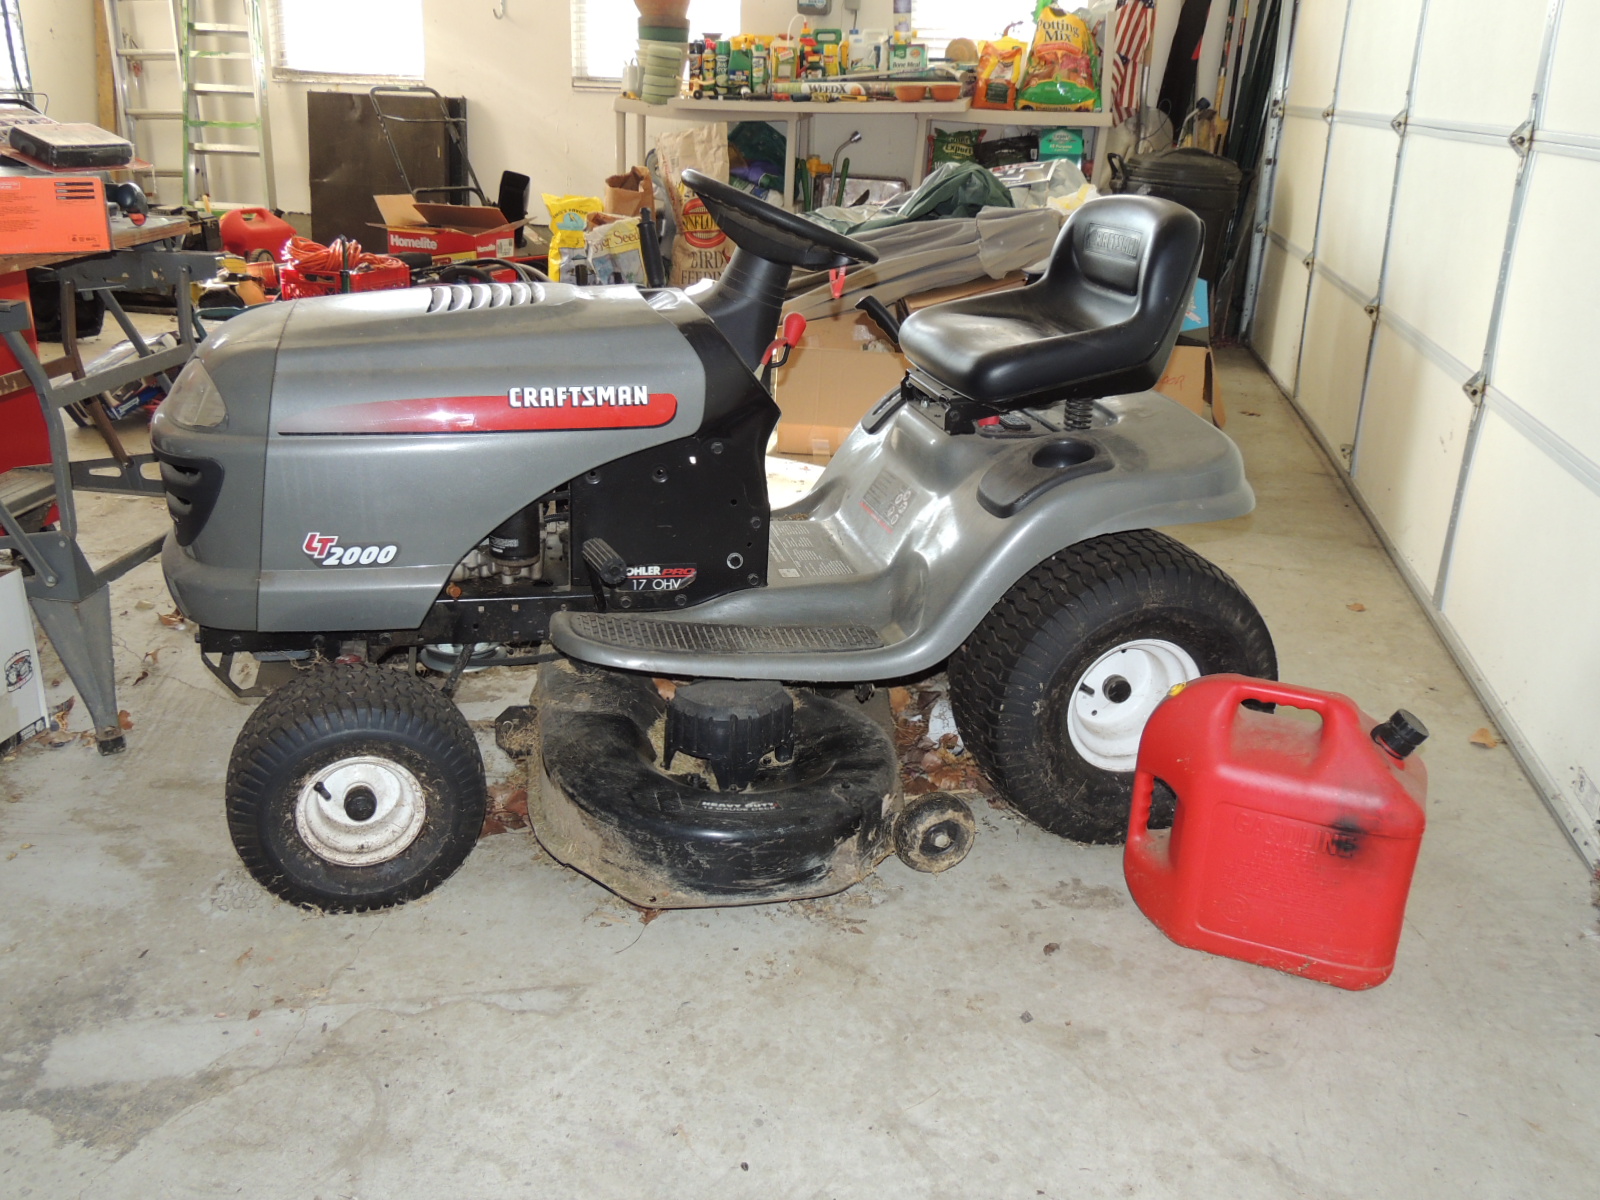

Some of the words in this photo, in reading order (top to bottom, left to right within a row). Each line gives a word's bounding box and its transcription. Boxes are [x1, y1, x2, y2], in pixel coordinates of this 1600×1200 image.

[1038, 18, 1080, 38] Potting
[1044, 30, 1072, 42] Mix
[390, 234, 438, 250] Homelite
[613, 228, 640, 245] Seed
[690, 250, 724, 269] BIRD
[508, 385, 648, 408] CRAFTSMAN
[302, 532, 339, 559] LT
[322, 545, 398, 566] 2000
[626, 566, 661, 576] OHLER
[661, 567, 696, 576] PRO
[632, 579, 648, 590] 17
[652, 579, 682, 590] OHV
[1233, 810, 1358, 859] GASOLINE
